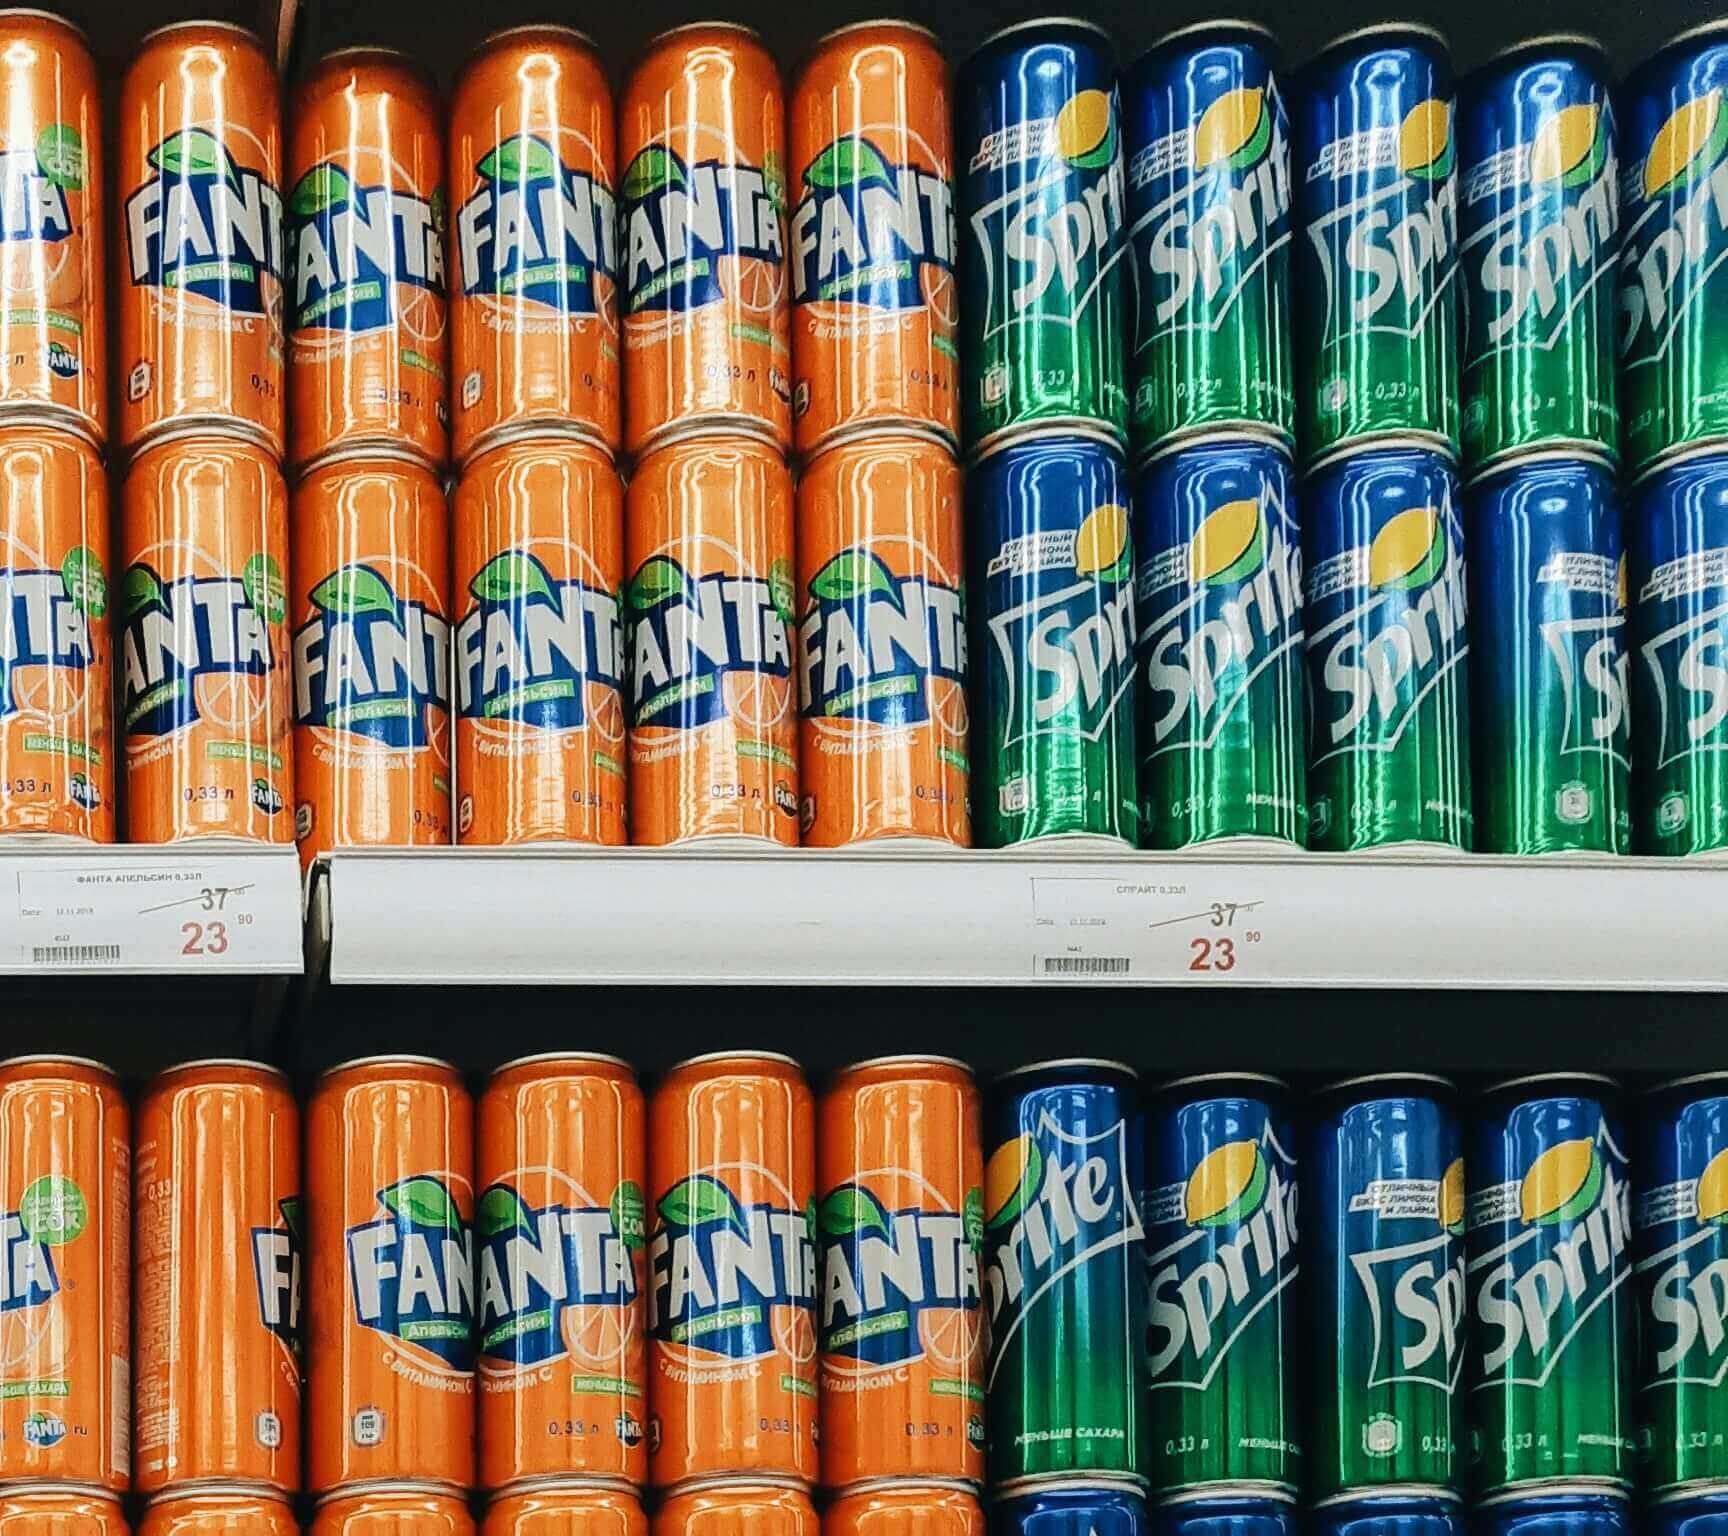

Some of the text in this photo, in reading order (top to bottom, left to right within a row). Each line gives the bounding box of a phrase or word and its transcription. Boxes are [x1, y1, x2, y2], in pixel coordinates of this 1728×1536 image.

[126, 172, 281, 278] FANT
[297, 612, 452, 721] FANT
[200, 888, 228, 911] 37
[1210, 903, 1236, 927] 37
[181, 914, 253, 955] 23 90
[1189, 932, 1260, 971] 23 90
